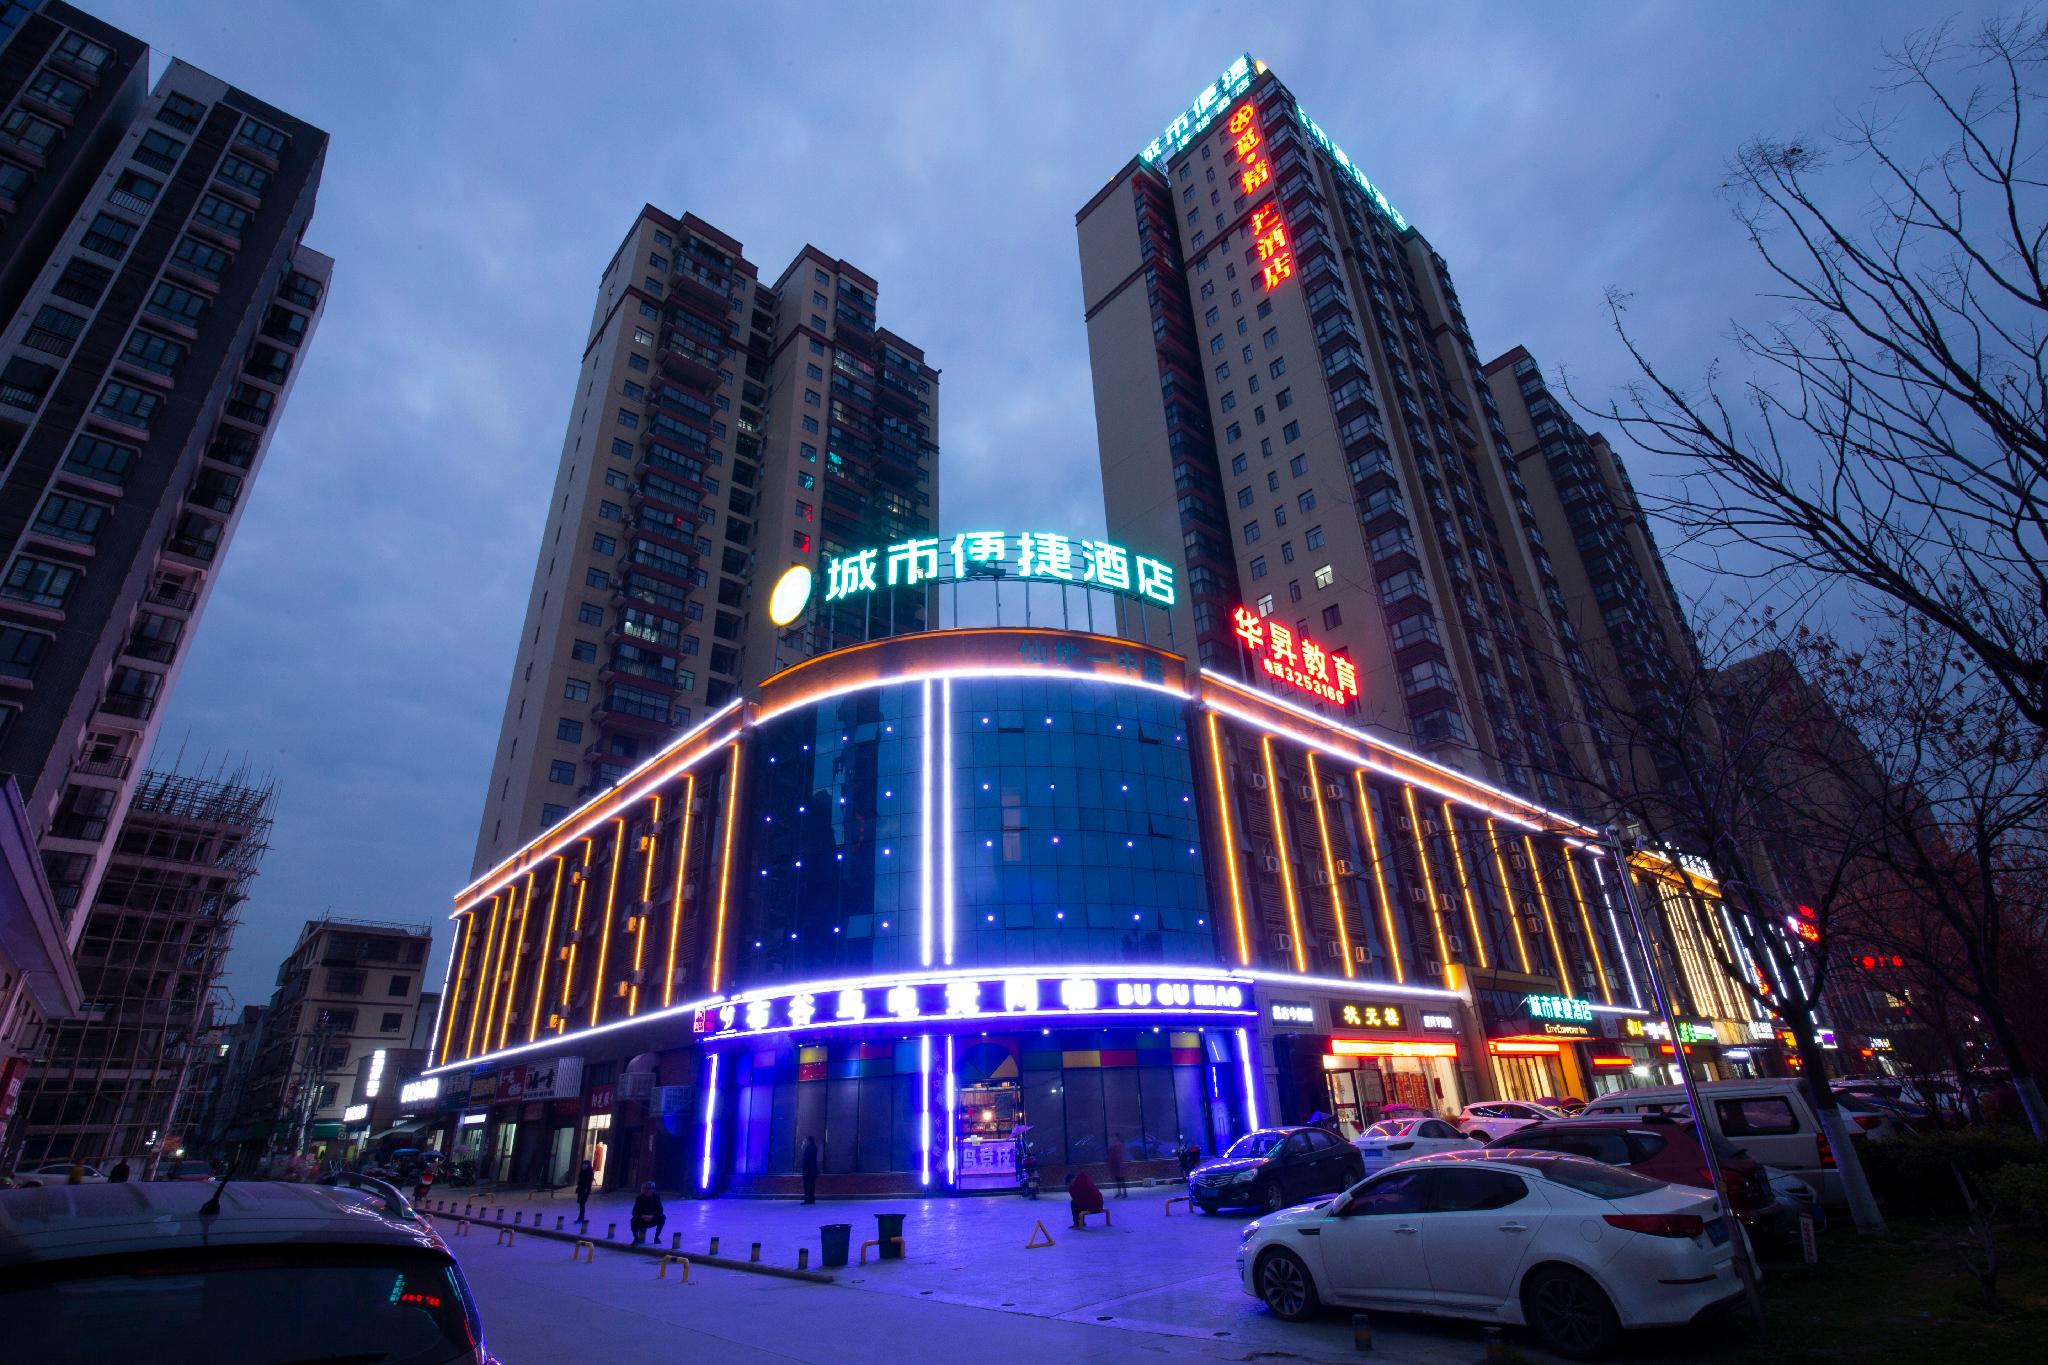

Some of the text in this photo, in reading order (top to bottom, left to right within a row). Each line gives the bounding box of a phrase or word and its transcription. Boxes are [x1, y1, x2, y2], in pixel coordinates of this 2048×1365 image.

[825, 530, 1176, 606] 城市便捷酒店
[1234, 607, 1358, 696] 华昇教育
